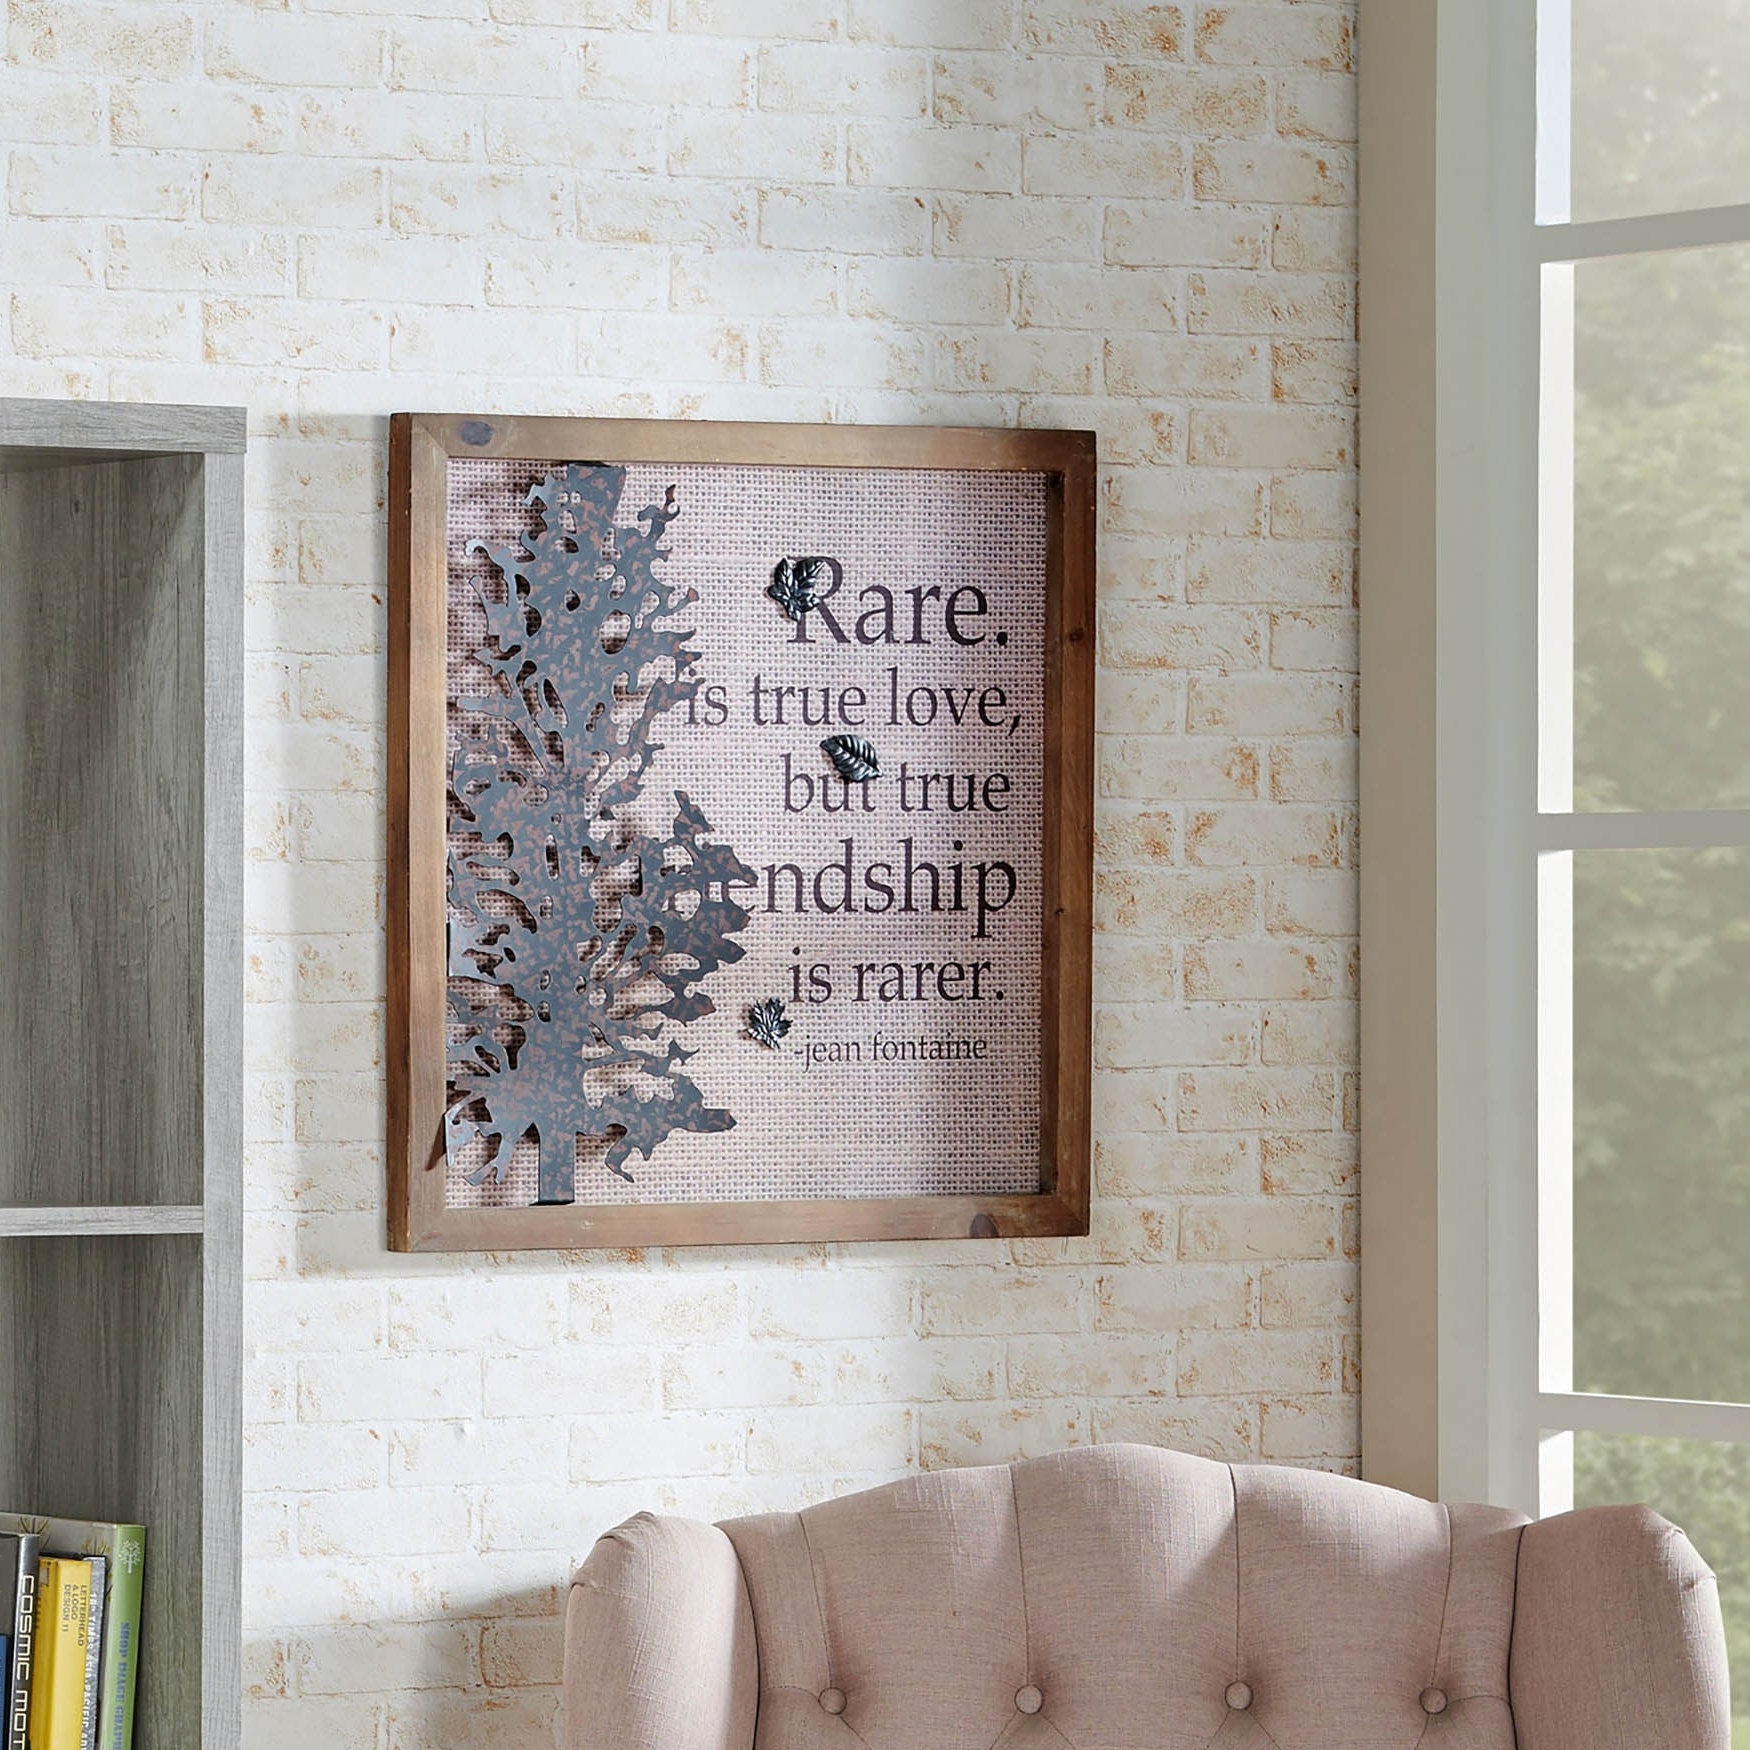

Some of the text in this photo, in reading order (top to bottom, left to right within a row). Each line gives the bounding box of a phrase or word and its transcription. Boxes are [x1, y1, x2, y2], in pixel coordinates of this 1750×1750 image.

[784, 556, 1008, 646] Rare.
[684, 666, 1021, 737] is true love,
[780, 753, 1010, 812] but true
[787, 946, 1005, 1003] is rarer.
[793, 1031, 987, 1073] -jean fontaine
[16, 1575, 35, 1681] COSMIC
[63, 1584, 71, 1621] DESIGN
[77, 1584, 88, 1647] LETTERHEAD
